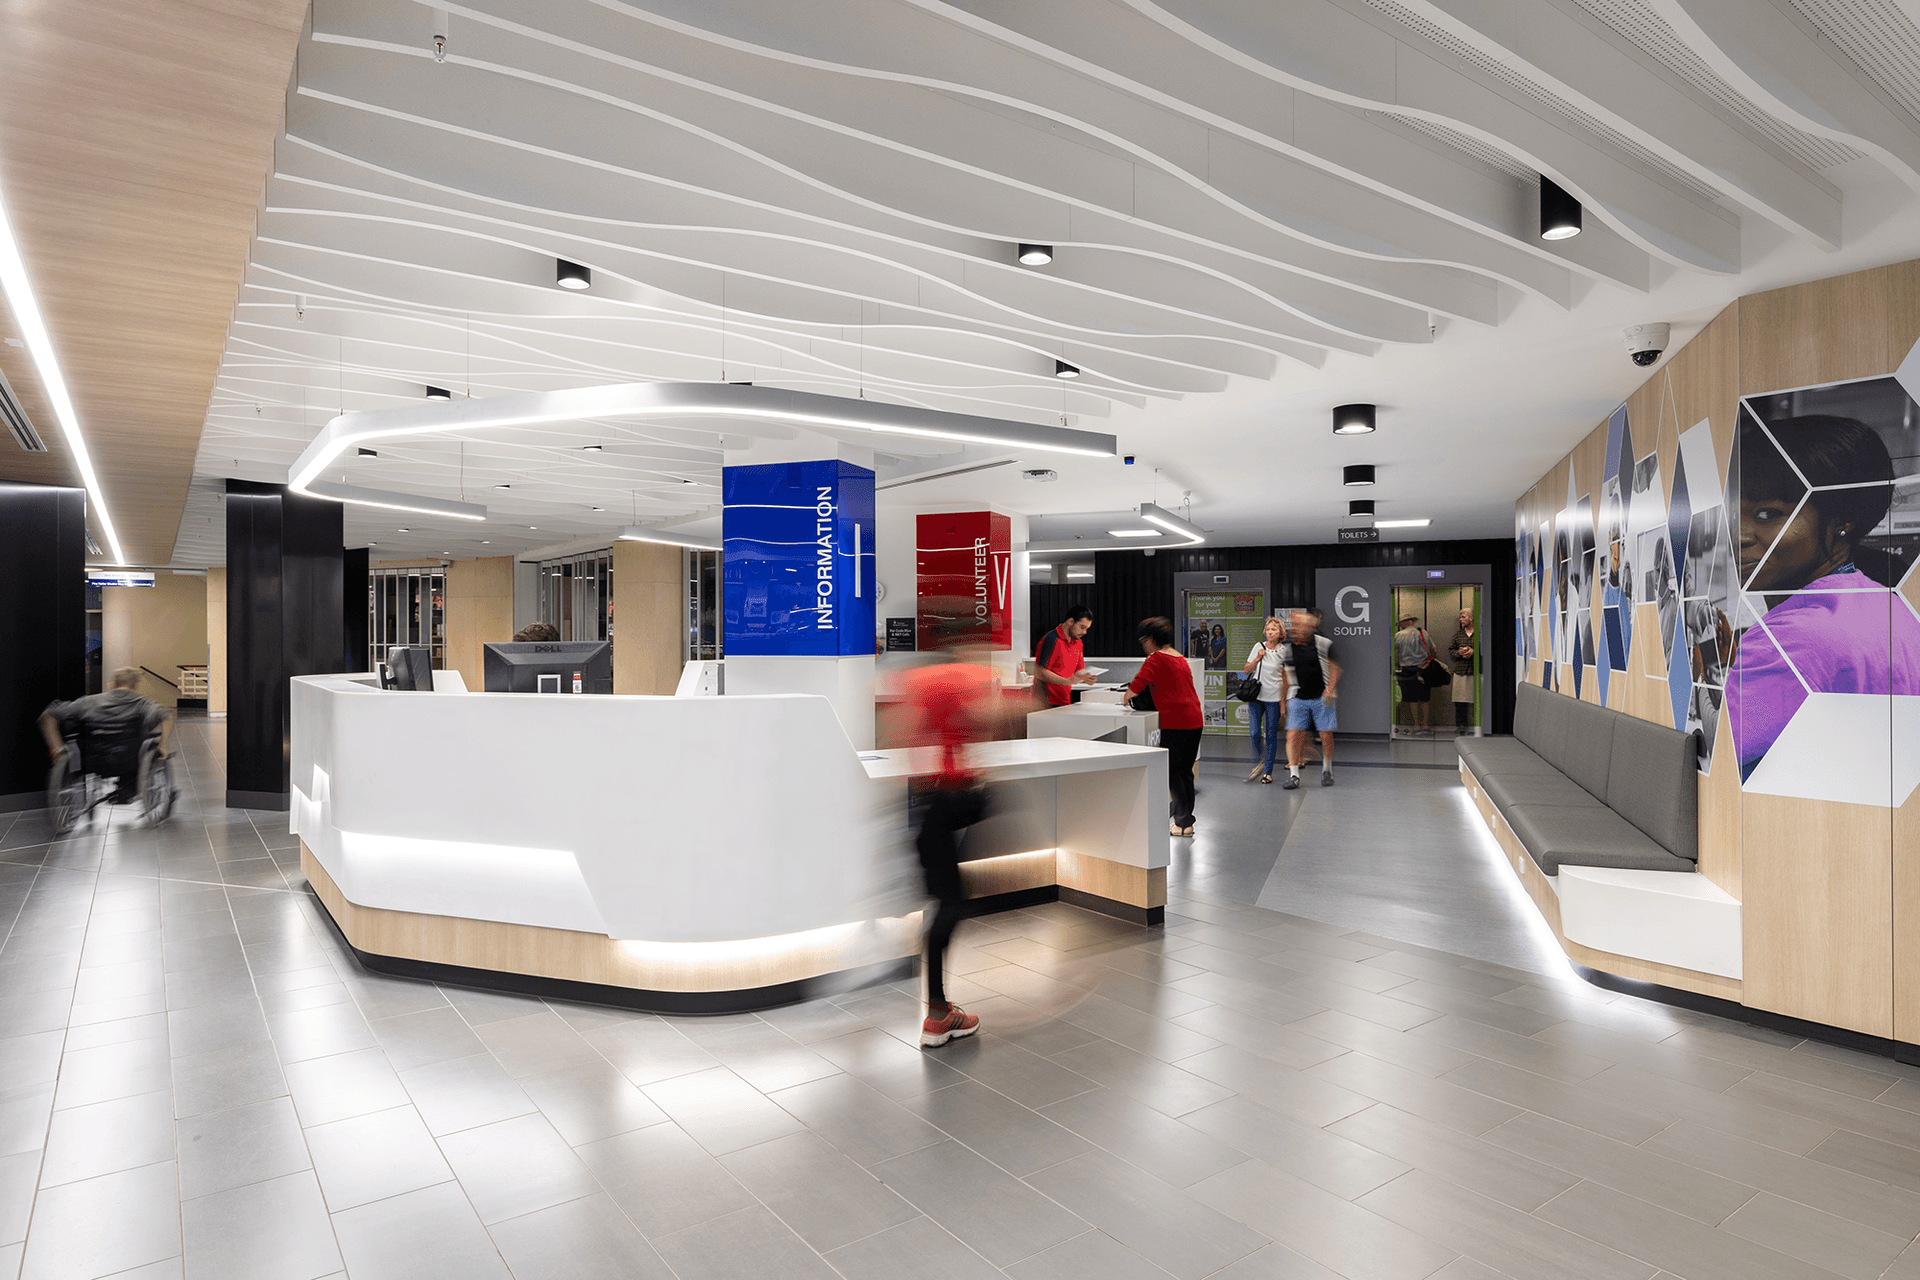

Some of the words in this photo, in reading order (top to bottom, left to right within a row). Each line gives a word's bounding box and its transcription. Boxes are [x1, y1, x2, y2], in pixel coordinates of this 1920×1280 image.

[817, 486, 833, 629] INFORMATION
[975, 537, 987, 626] VOLUNTEER
[994, 555, 1009, 610] V
[1195, 608, 1221, 616] support
[1334, 585, 1370, 624] G
[535, 645, 562, 653] DELL
[1333, 626, 1371, 636] SOUTH
